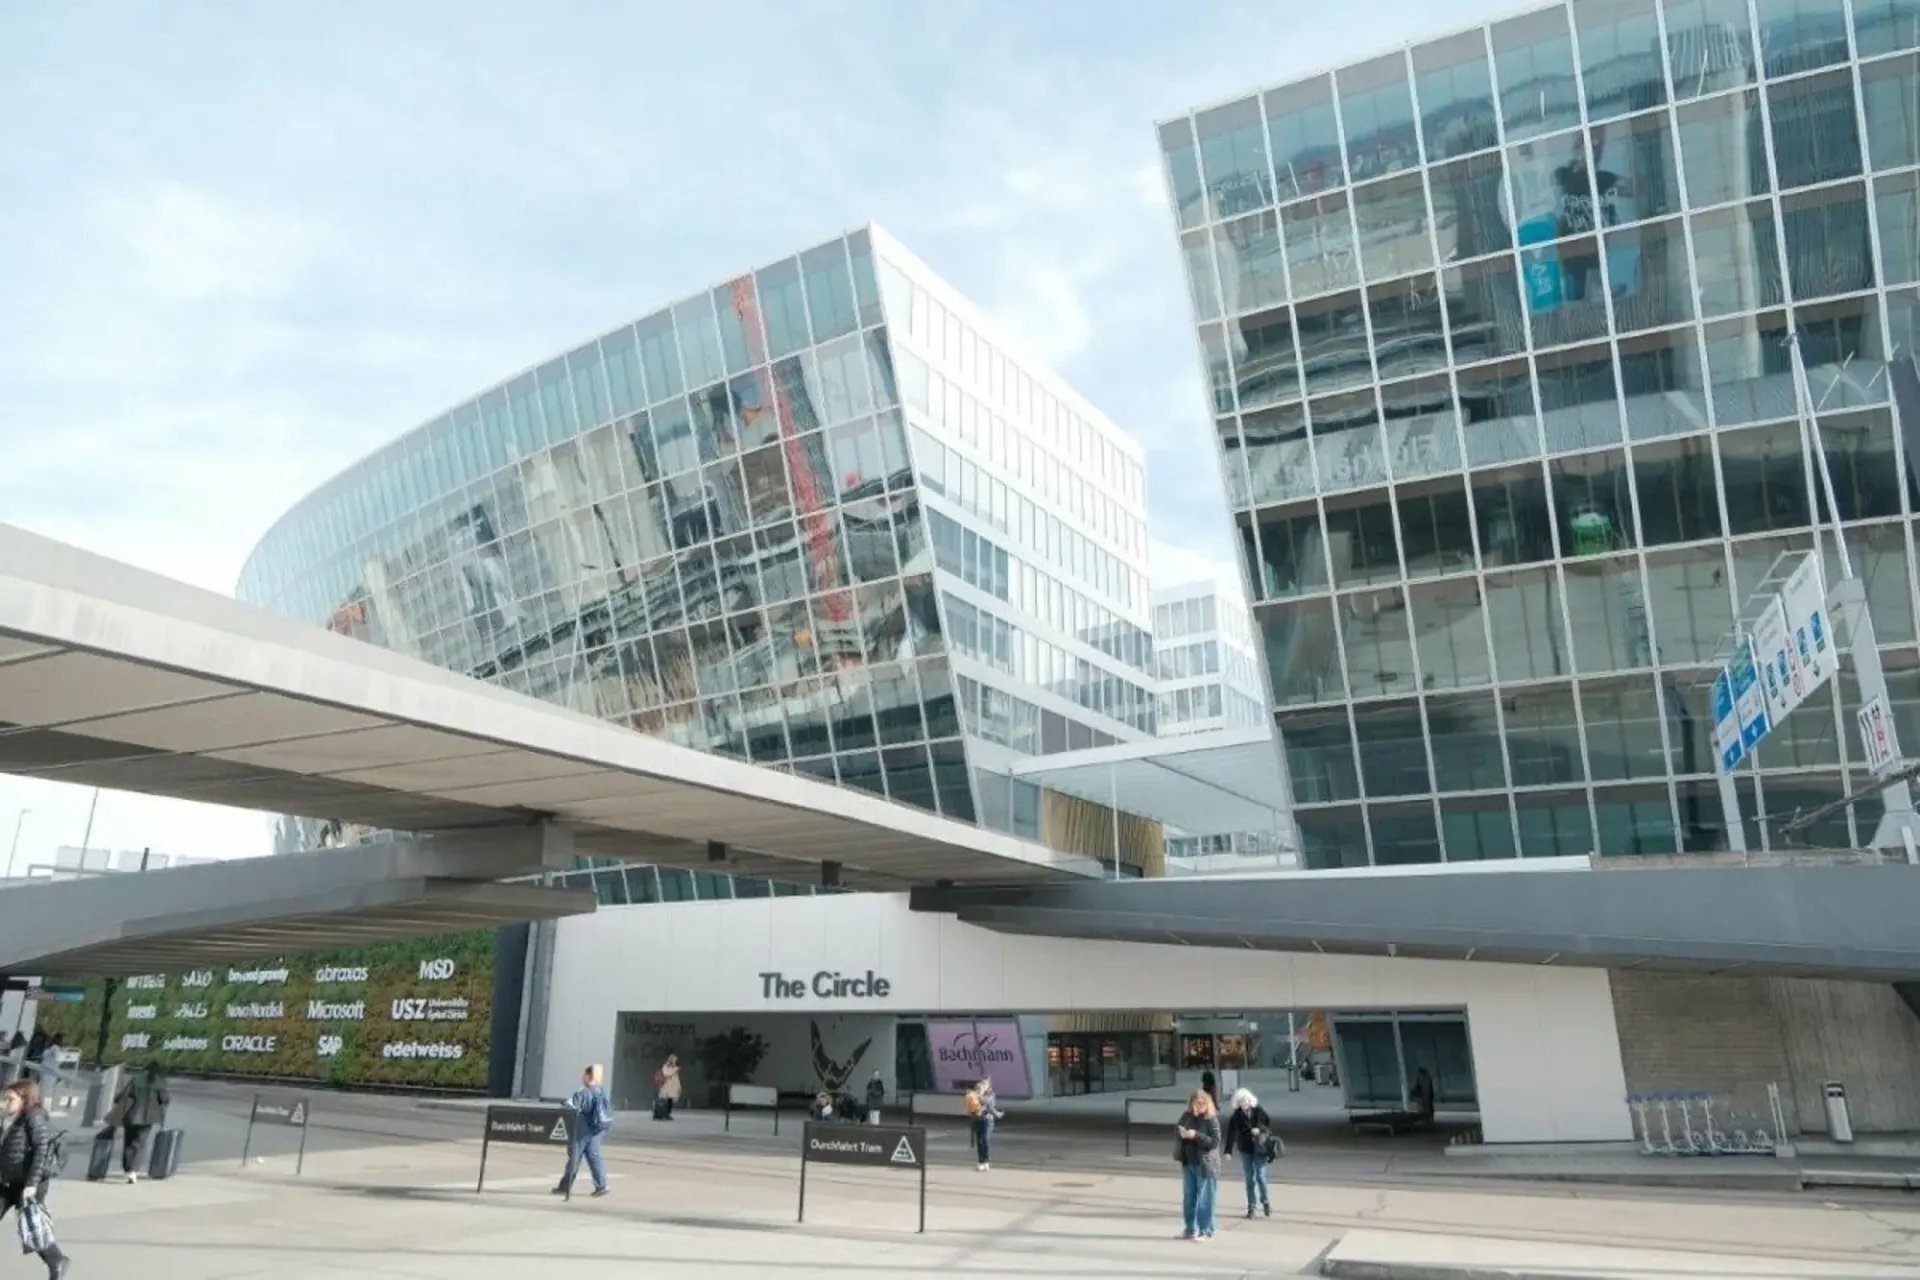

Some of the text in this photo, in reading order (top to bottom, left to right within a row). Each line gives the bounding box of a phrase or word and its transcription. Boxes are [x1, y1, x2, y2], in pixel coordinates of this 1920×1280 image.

[316, 965, 369, 982] abraxas
[419, 959, 455, 980] MSD
[758, 970, 890, 998] The Circle
[307, 999, 366, 1020] Microsoft
[391, 999, 427, 1020] USZ
[222, 1035, 277, 1052] ORACLE
[317, 1035, 343, 1056] SAP
[383, 1041, 463, 1058] edelweiss
[938, 1046, 1014, 1063] Bachmann
[860, 1141, 883, 1153] Tram
